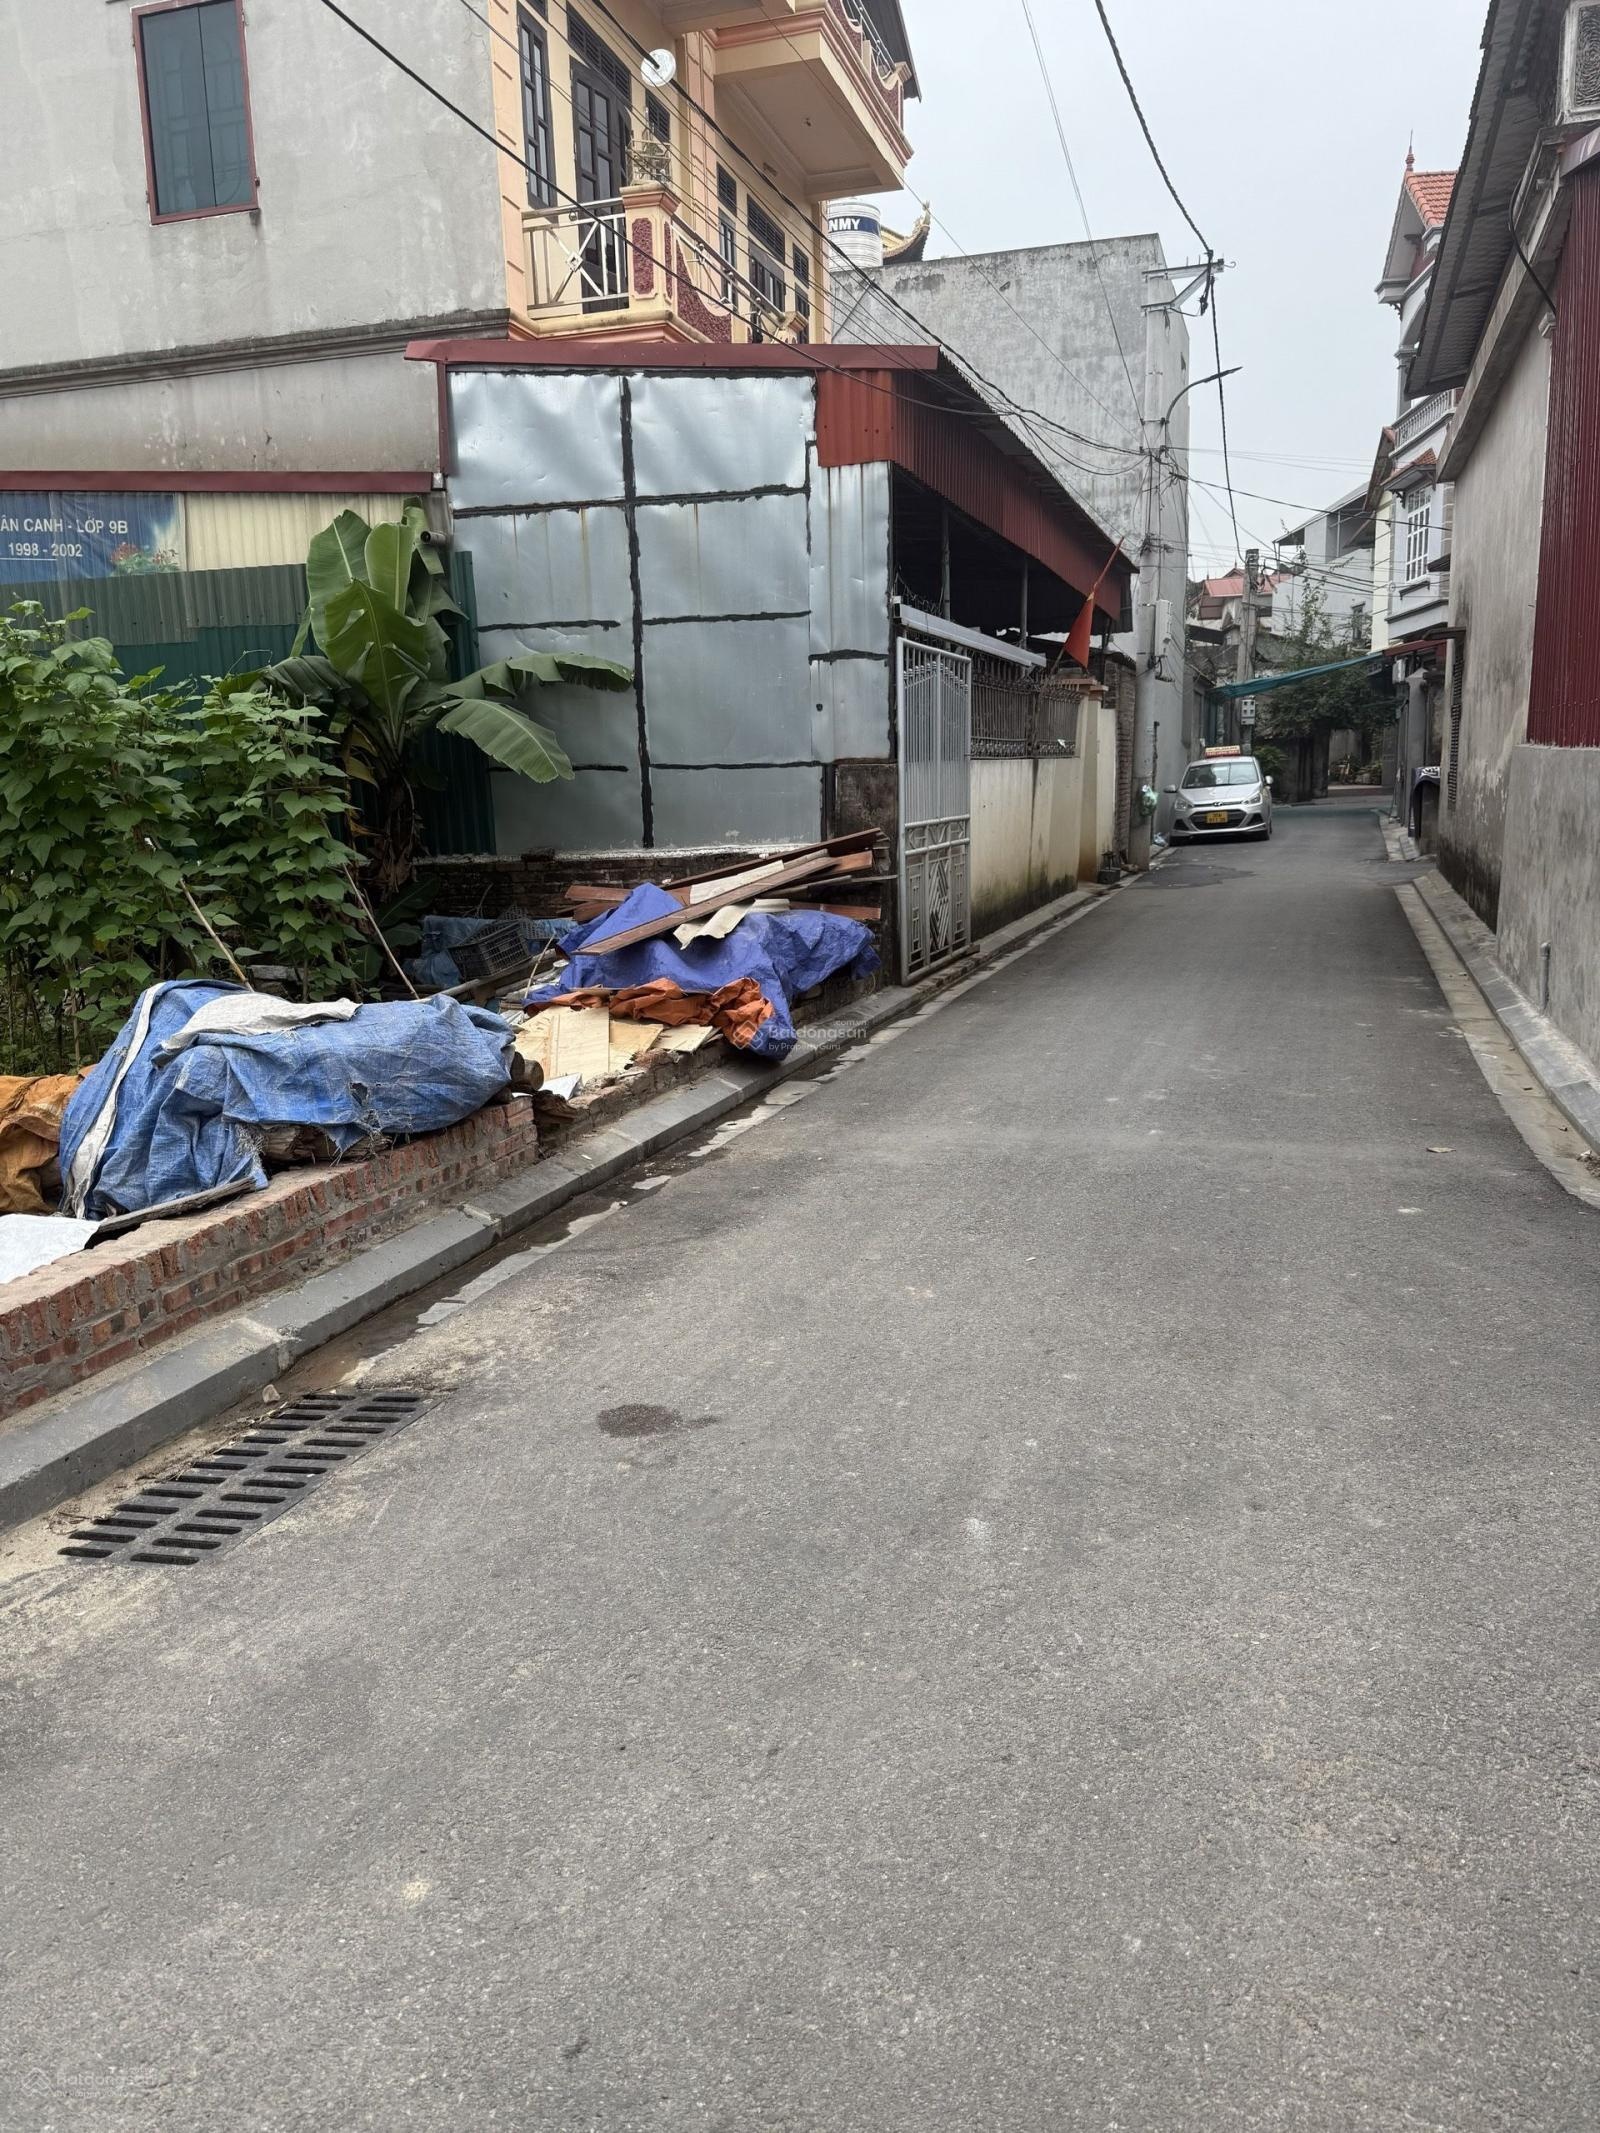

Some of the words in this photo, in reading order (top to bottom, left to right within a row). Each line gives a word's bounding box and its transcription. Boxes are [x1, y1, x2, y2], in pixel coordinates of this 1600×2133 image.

[23, 518, 63, 533] CANH
[76, 515, 104, 534] LỚP
[109, 520, 128, 534] 9B
[8, 542, 39, 556] 1998
[51, 543, 83, 557] 2002
